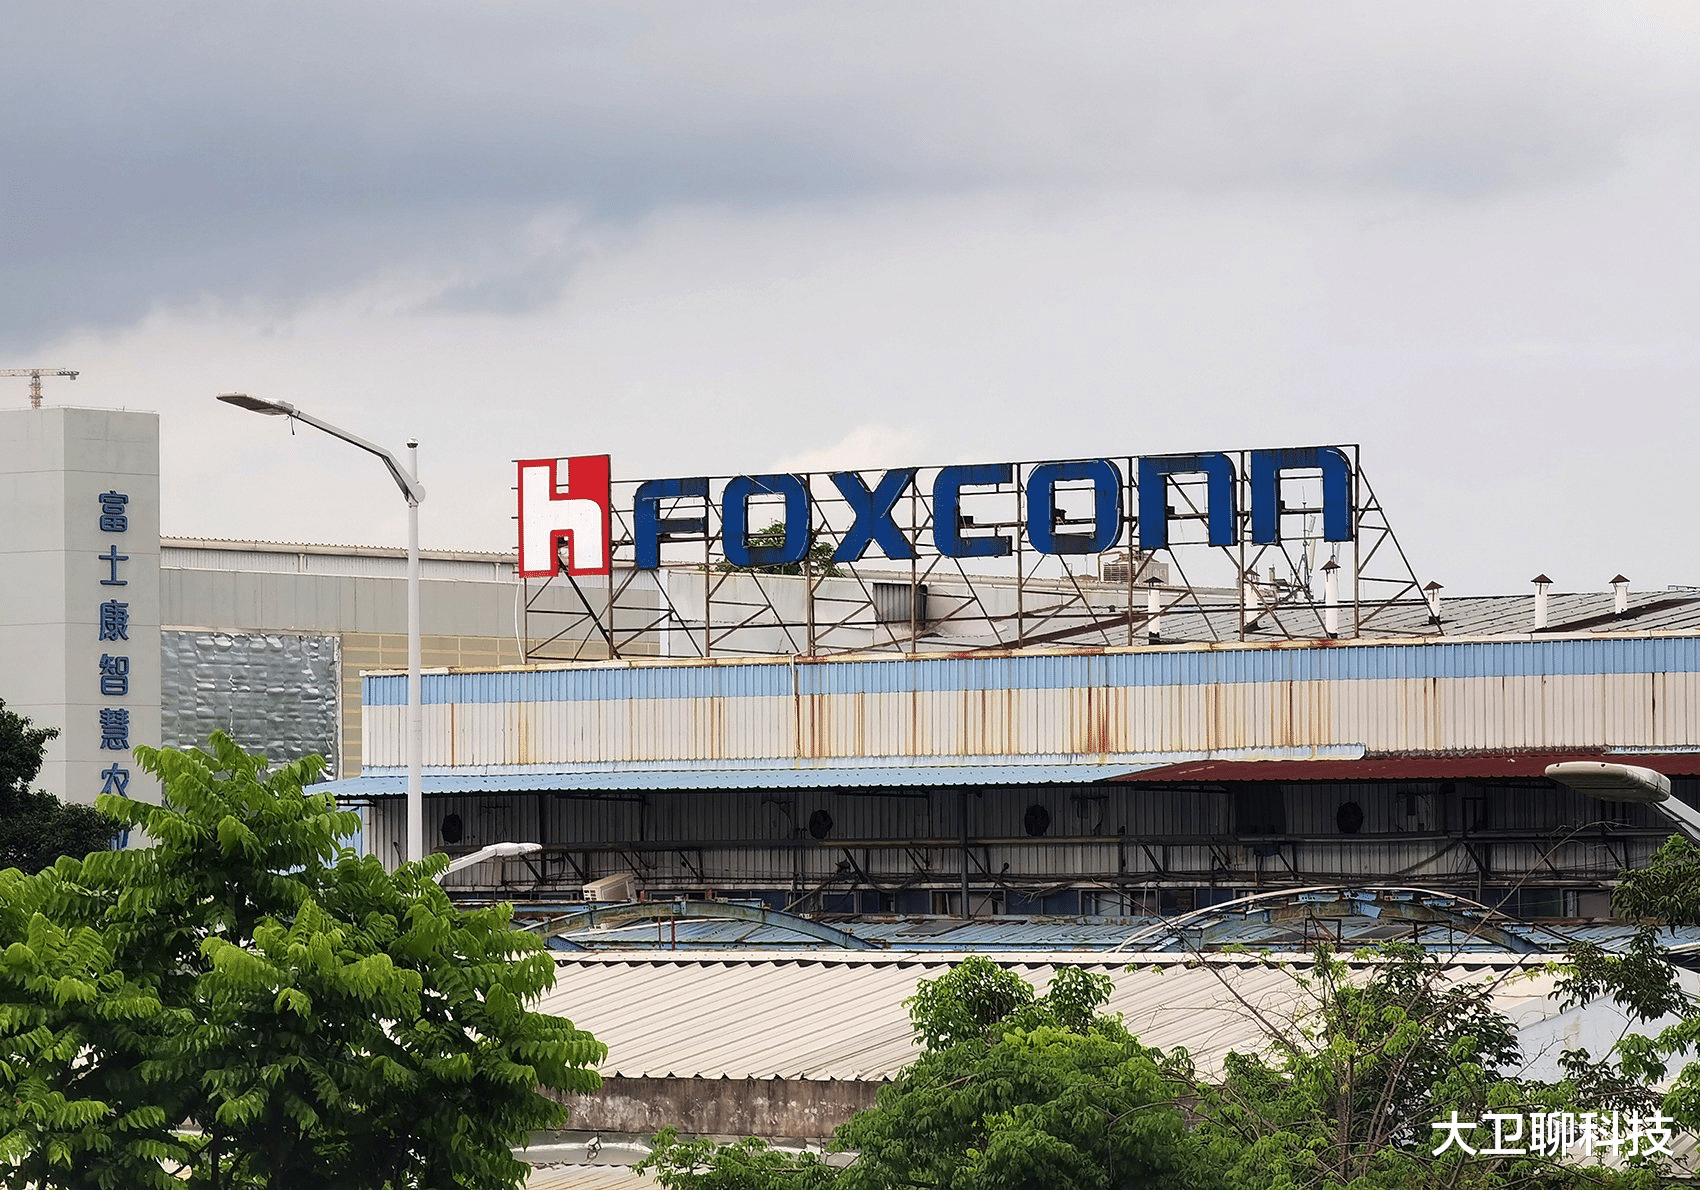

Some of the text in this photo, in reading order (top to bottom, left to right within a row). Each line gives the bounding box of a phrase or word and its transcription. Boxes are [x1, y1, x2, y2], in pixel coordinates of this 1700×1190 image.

[98, 490, 131, 850] 富士康智慧农
